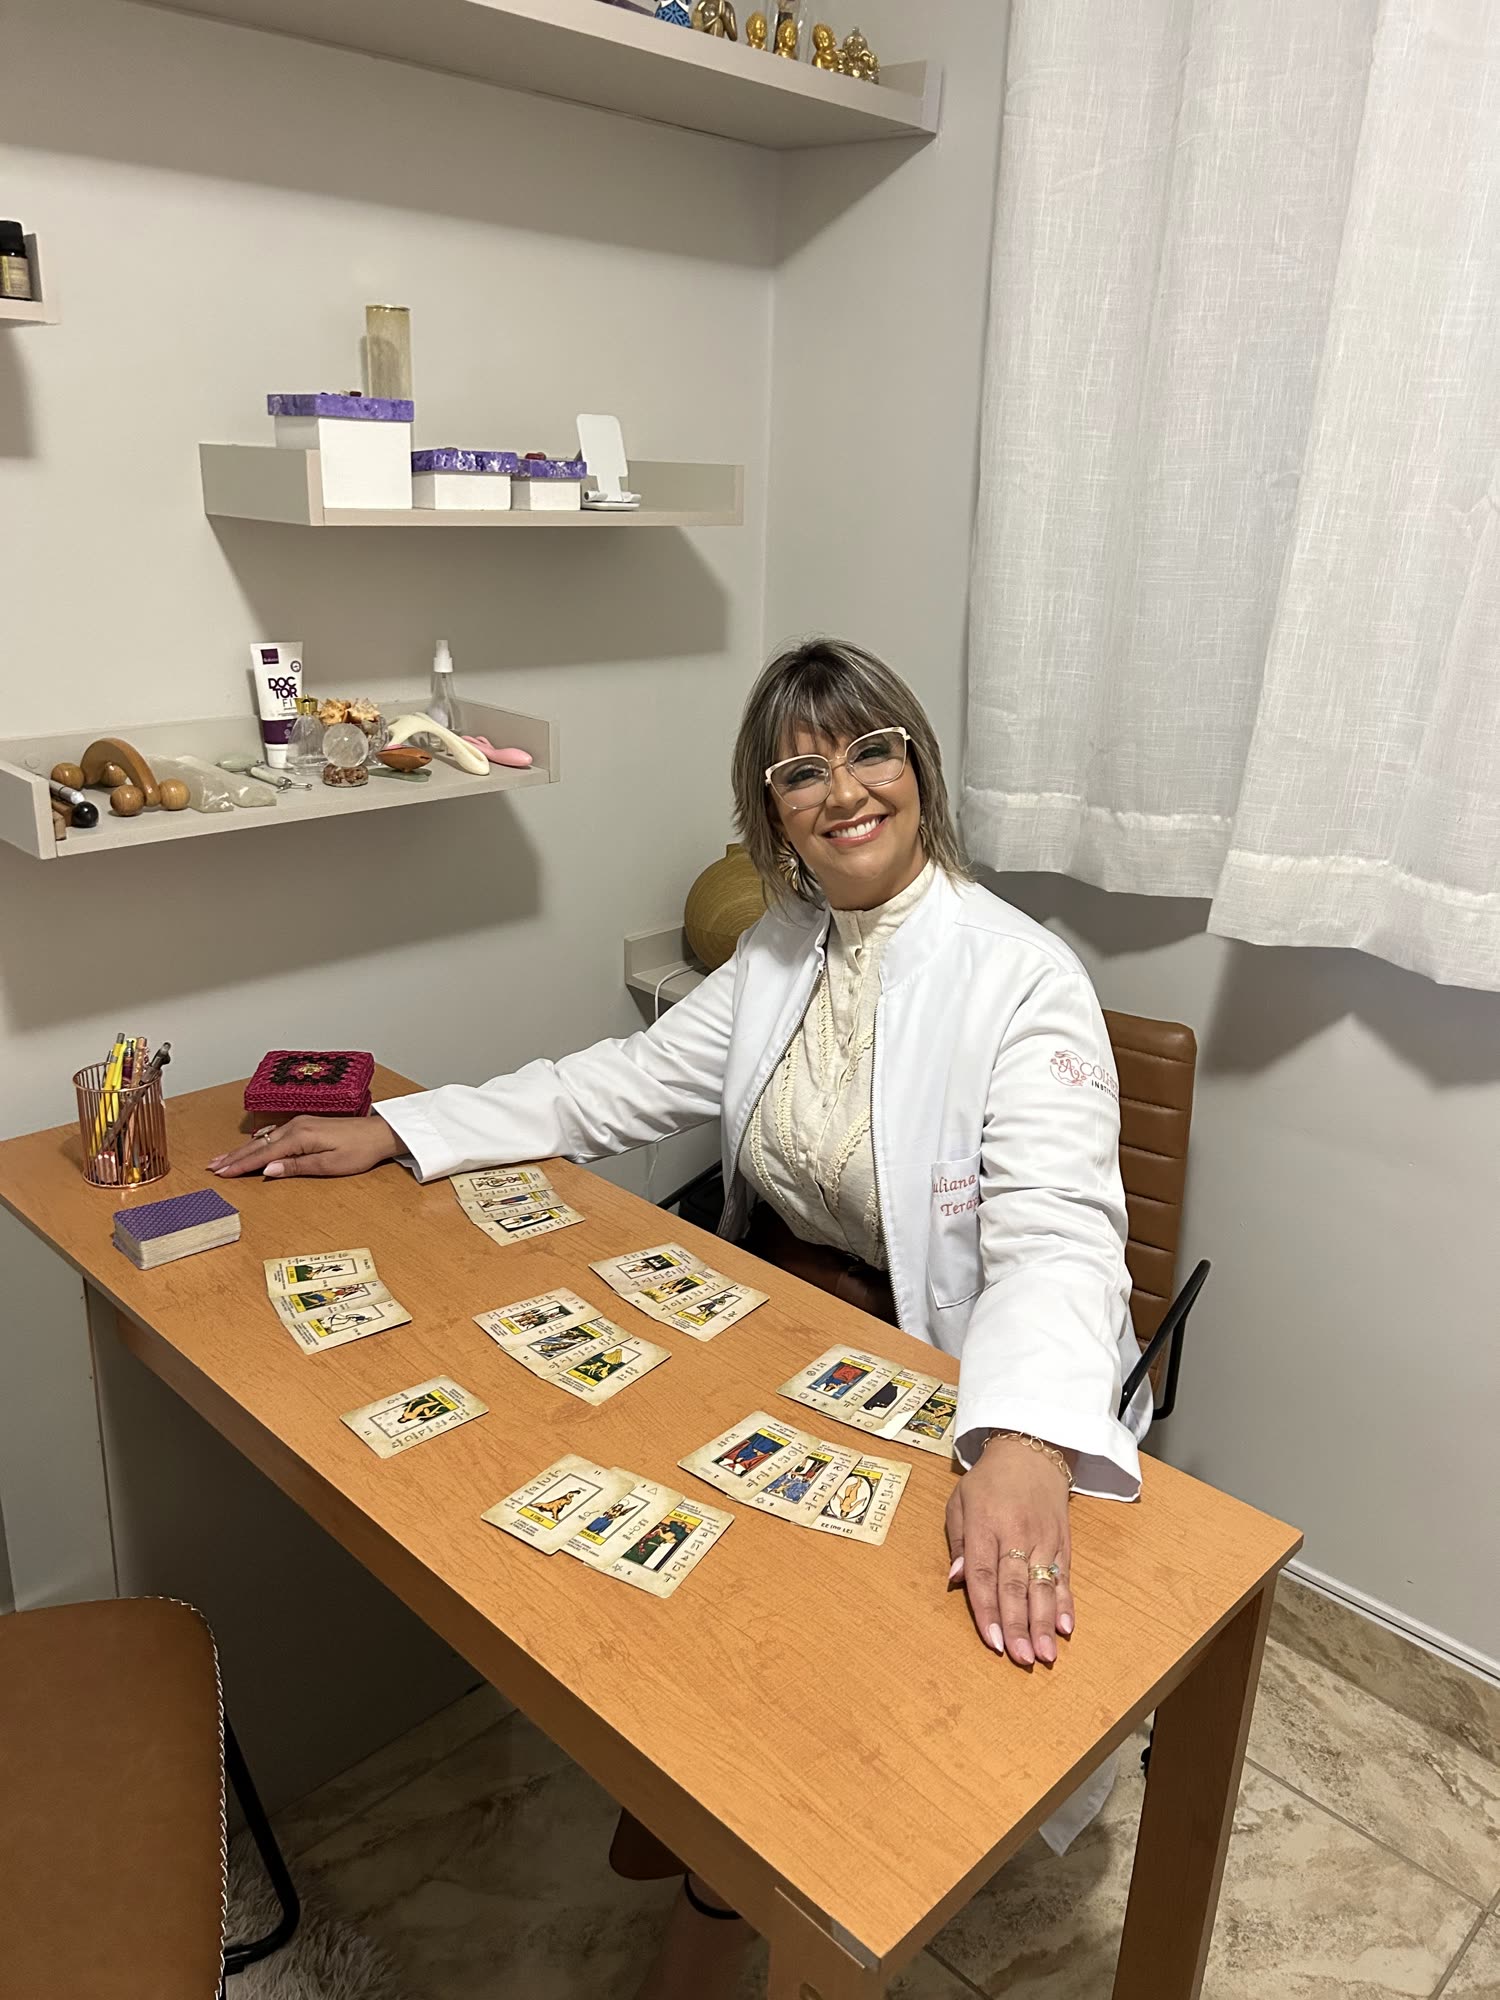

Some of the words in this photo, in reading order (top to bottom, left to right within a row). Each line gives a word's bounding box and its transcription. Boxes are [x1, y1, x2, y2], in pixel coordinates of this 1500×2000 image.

[267, 676, 297, 690] DOC
[272, 687, 298, 700] TOR
[933, 1174, 977, 1194] uliana
